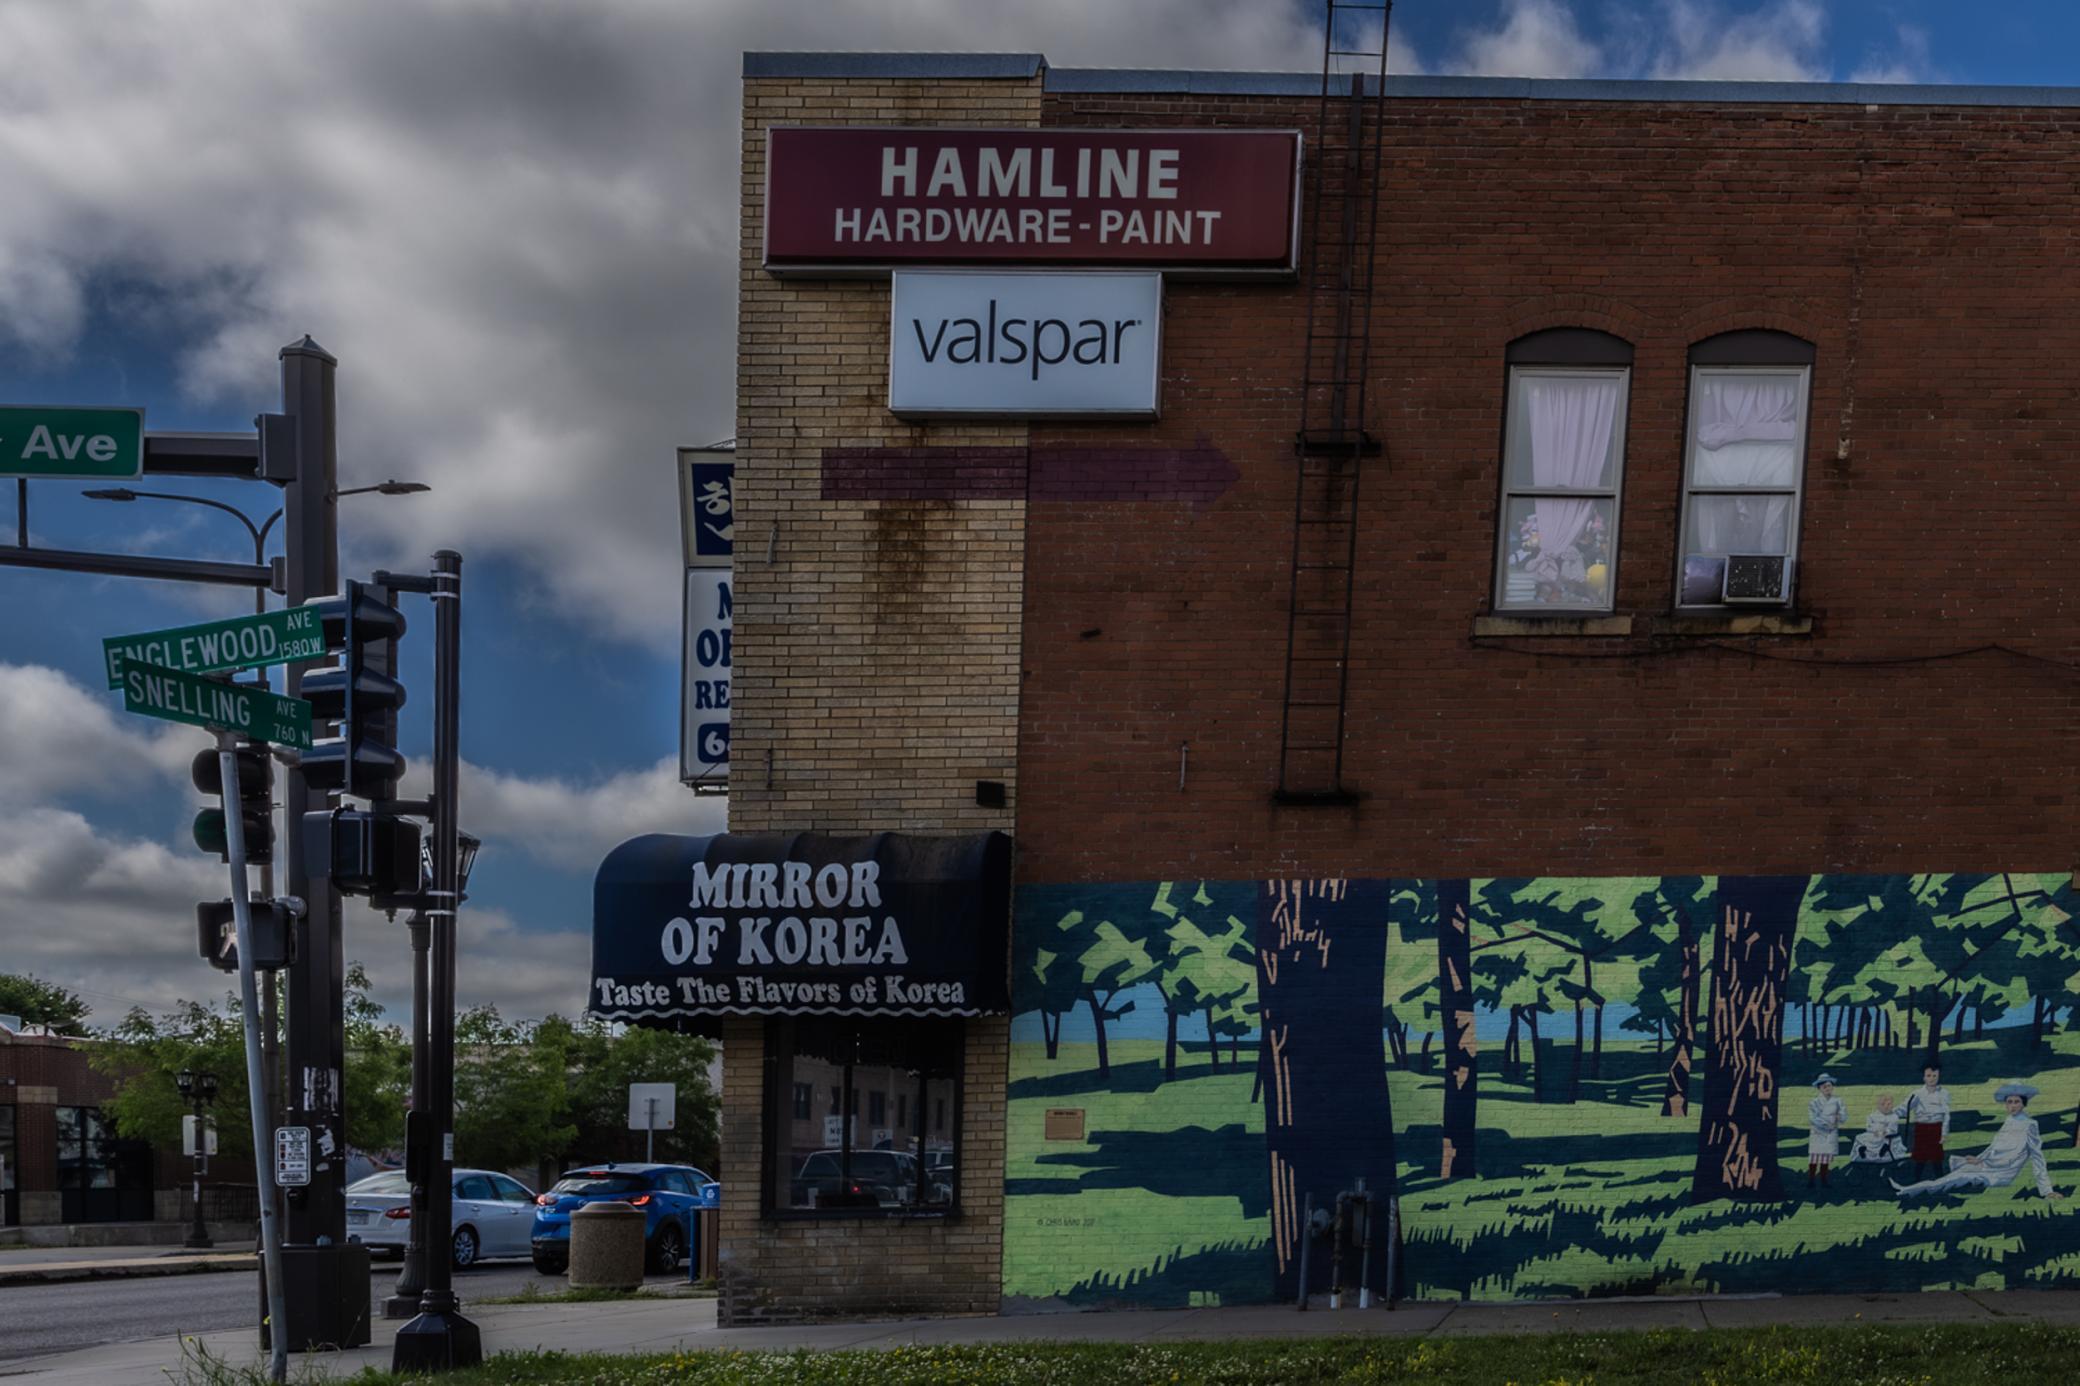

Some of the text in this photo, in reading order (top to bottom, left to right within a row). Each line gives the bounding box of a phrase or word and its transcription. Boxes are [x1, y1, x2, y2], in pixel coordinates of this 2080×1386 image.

[880, 146, 1181, 199] HAMLINE
[912, 300, 1136, 381] valspar
[20, 424, 118, 462] Ave
[107, 610, 313, 680] ENGLEWOOD AVE
[128, 670, 299, 727] SNELLING AVE
[272, 723, 311, 745] 760 N
[688, 859, 883, 910] MIRROR
[660, 915, 910, 967] OF KOREA
[596, 974, 966, 1008] Taste The Flavors of Korea
